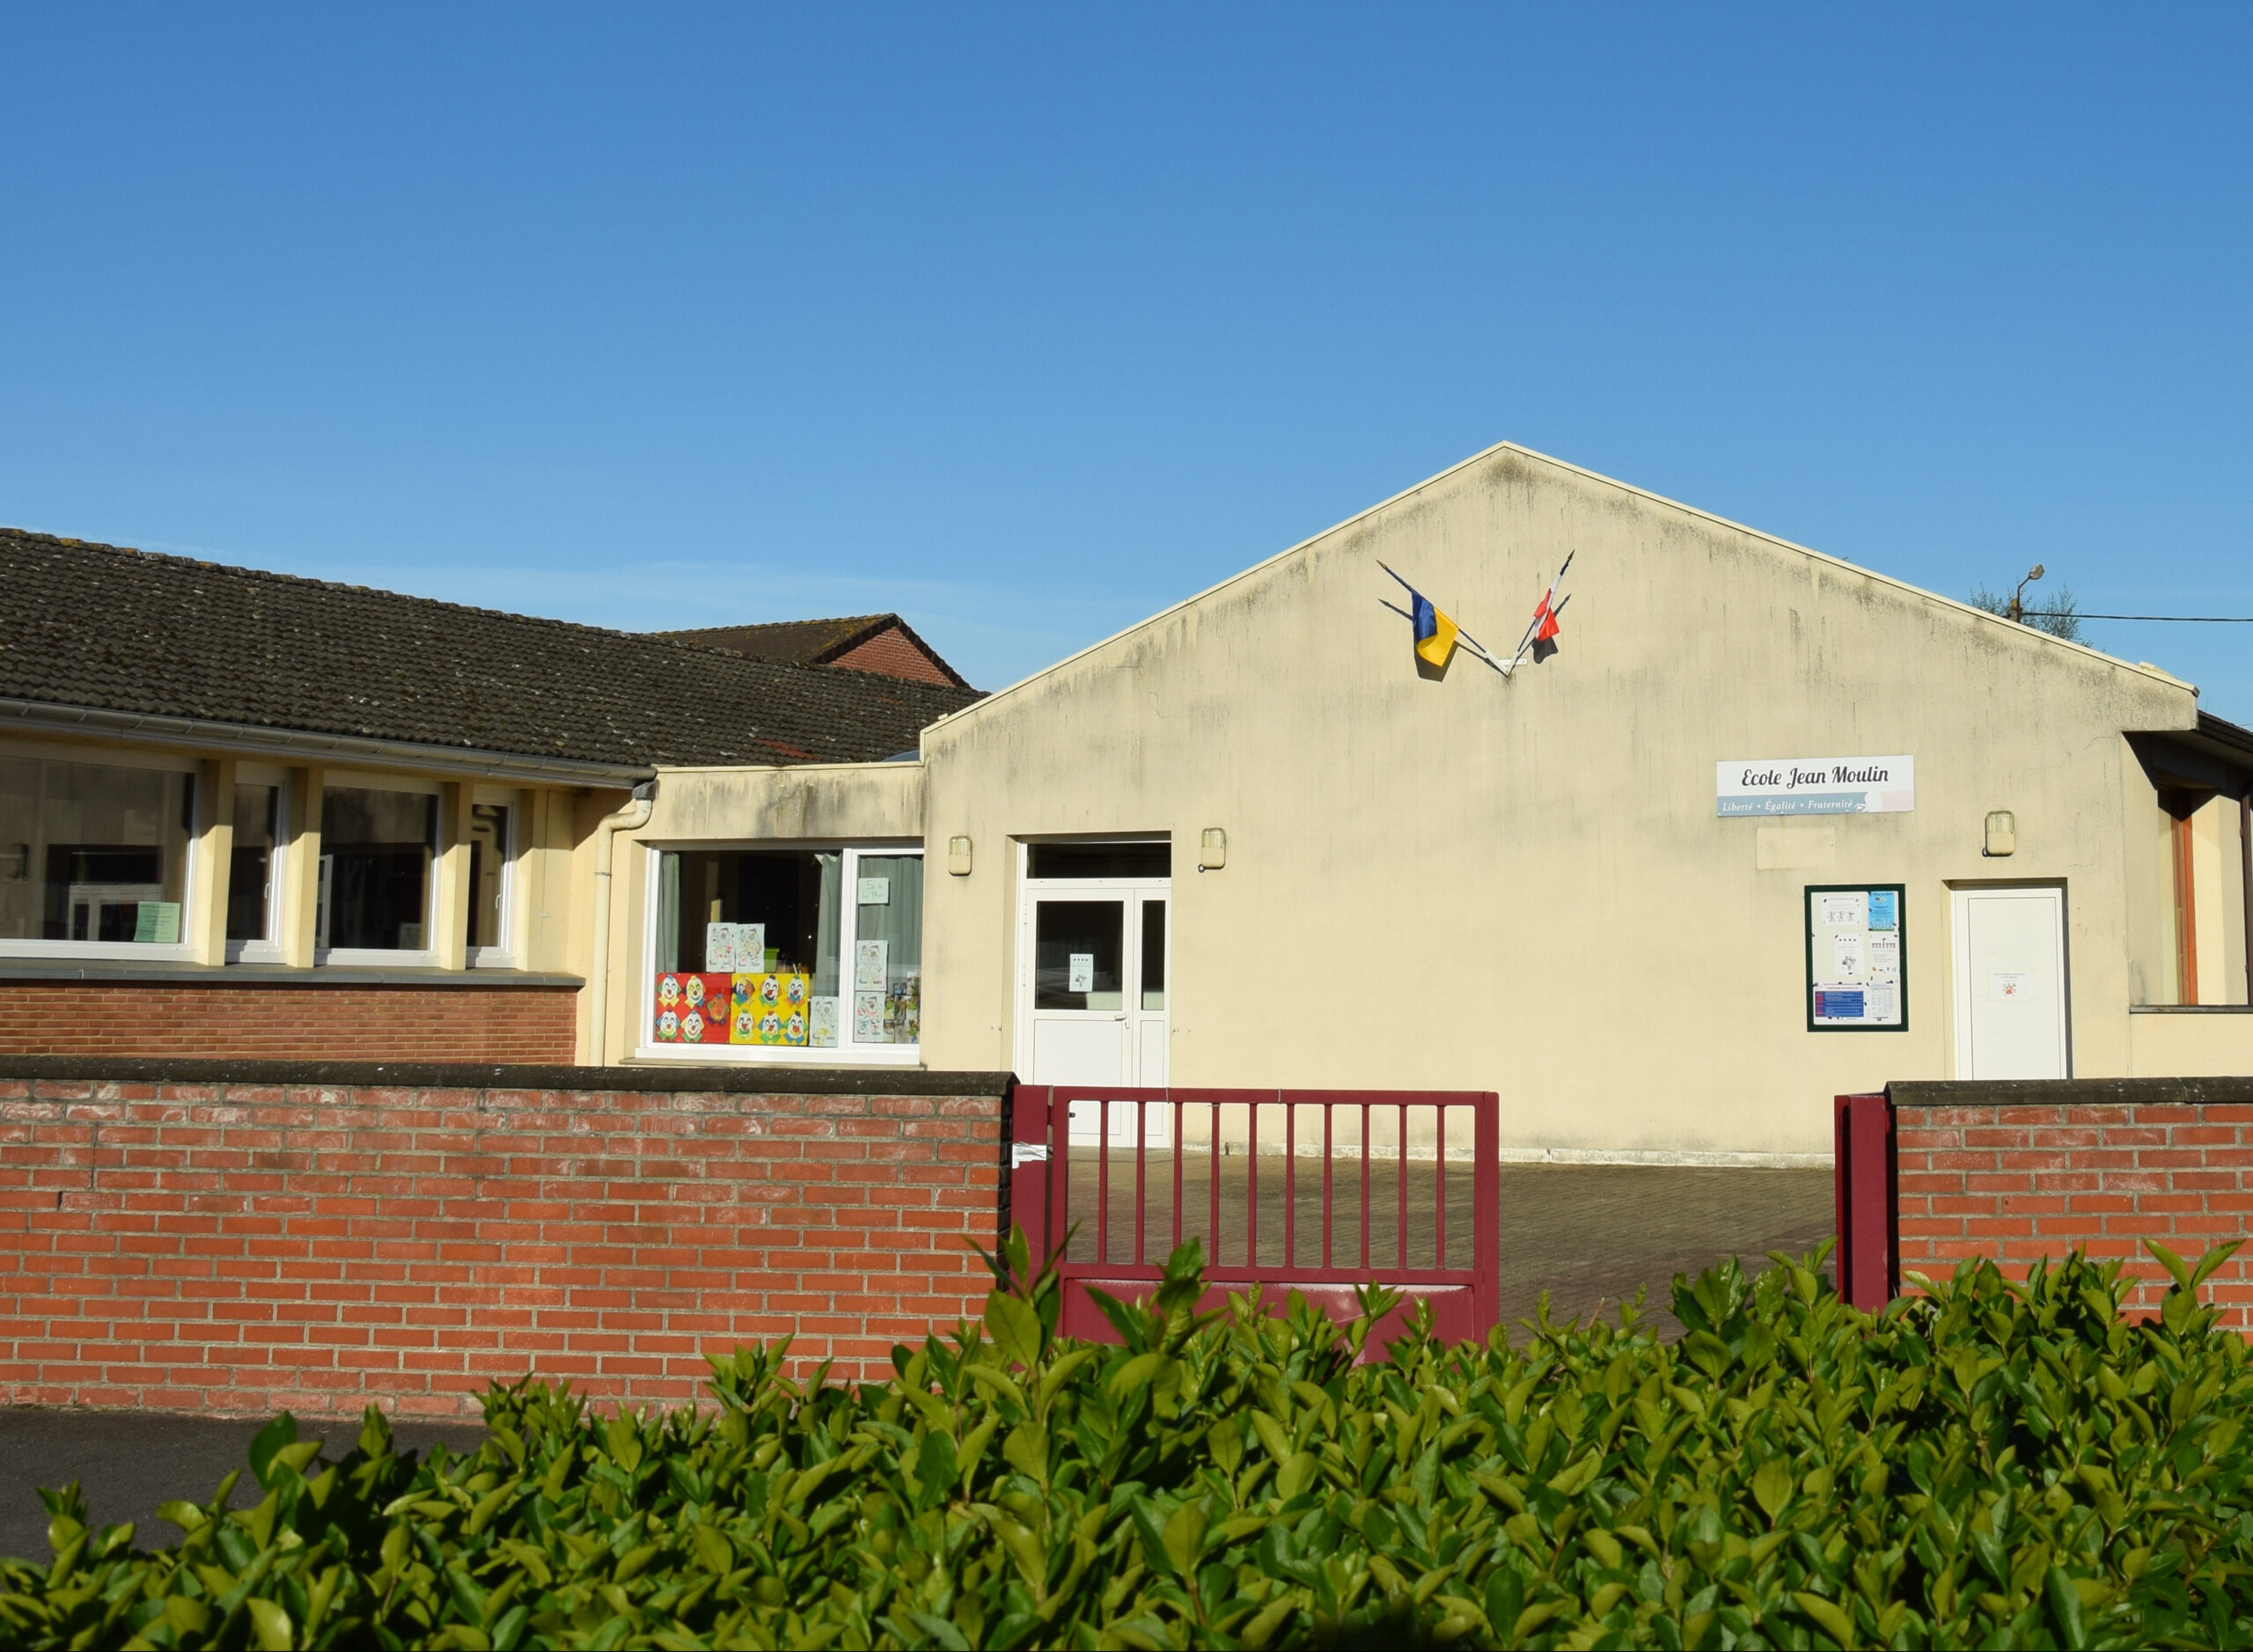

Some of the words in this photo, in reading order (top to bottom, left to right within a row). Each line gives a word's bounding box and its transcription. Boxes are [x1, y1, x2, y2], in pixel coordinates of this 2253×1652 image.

[1742, 768, 1782, 786] Ecole
[1786, 767, 1826, 789] Jean
[1831, 766, 1889, 783] Moulin
[1722, 802, 1754, 811] Liberté
[1765, 798, 1796, 812] Égalité
[1808, 799, 1853, 810] Fraternité
